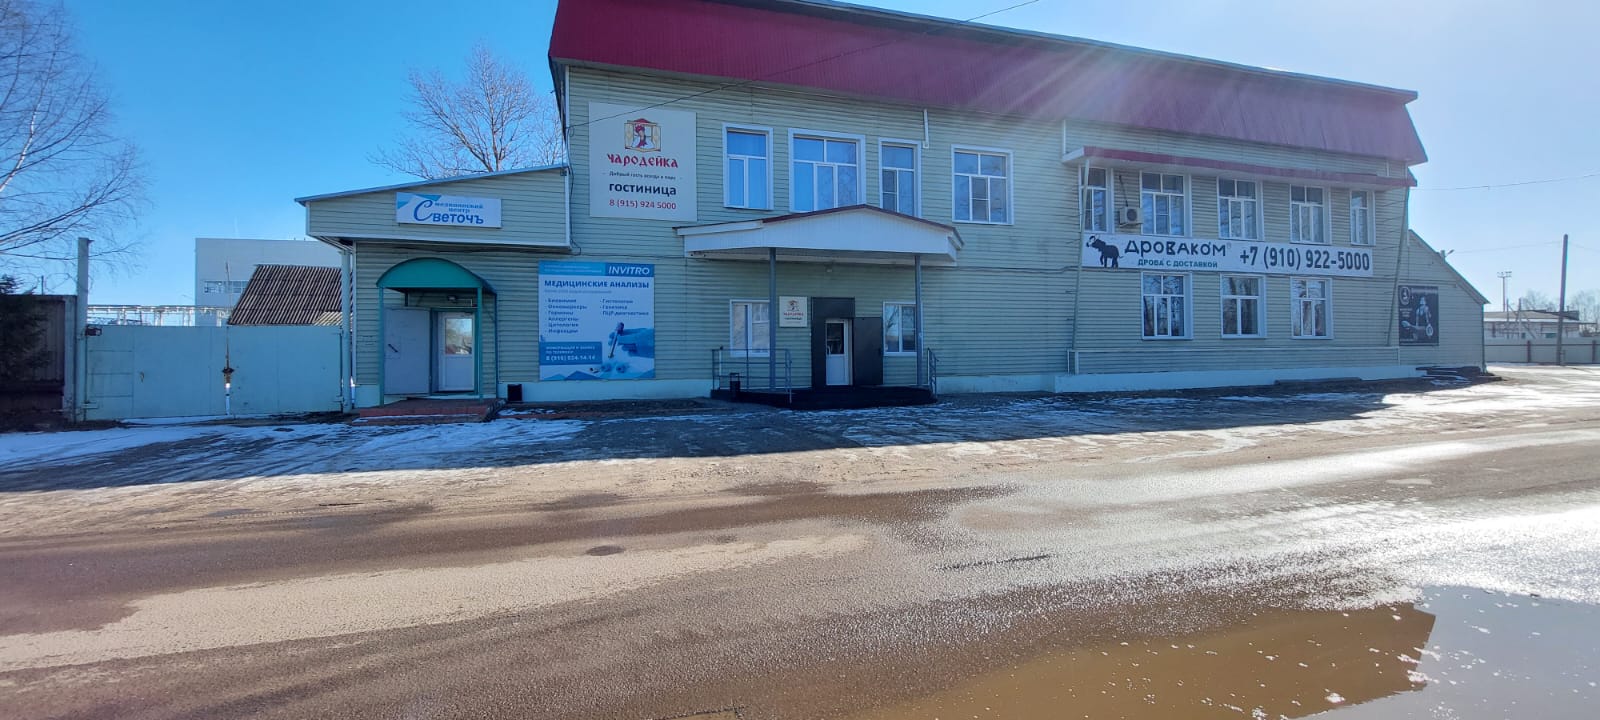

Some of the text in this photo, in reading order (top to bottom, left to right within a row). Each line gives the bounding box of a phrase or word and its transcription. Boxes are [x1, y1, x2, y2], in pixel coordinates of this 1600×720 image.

[609, 183, 676, 197] гостиница
[617, 200, 638, 208] (915)
[641, 200, 655, 208] 924
[413, 199, 484, 224] Светочъ
[1124, 240, 1226, 257] ДРОВАКОМ
[1138, 258, 1164, 266] ДРОВА
[1172, 260, 1218, 268] ДОСТАВКОЙ
[1239, 246, 1370, 271] +7 (910) 922-5000
[608, 265, 650, 275] INVITRO
[544, 280, 649, 289] МЕДИЦИНСКИЕ АНАЛИЗЫ
